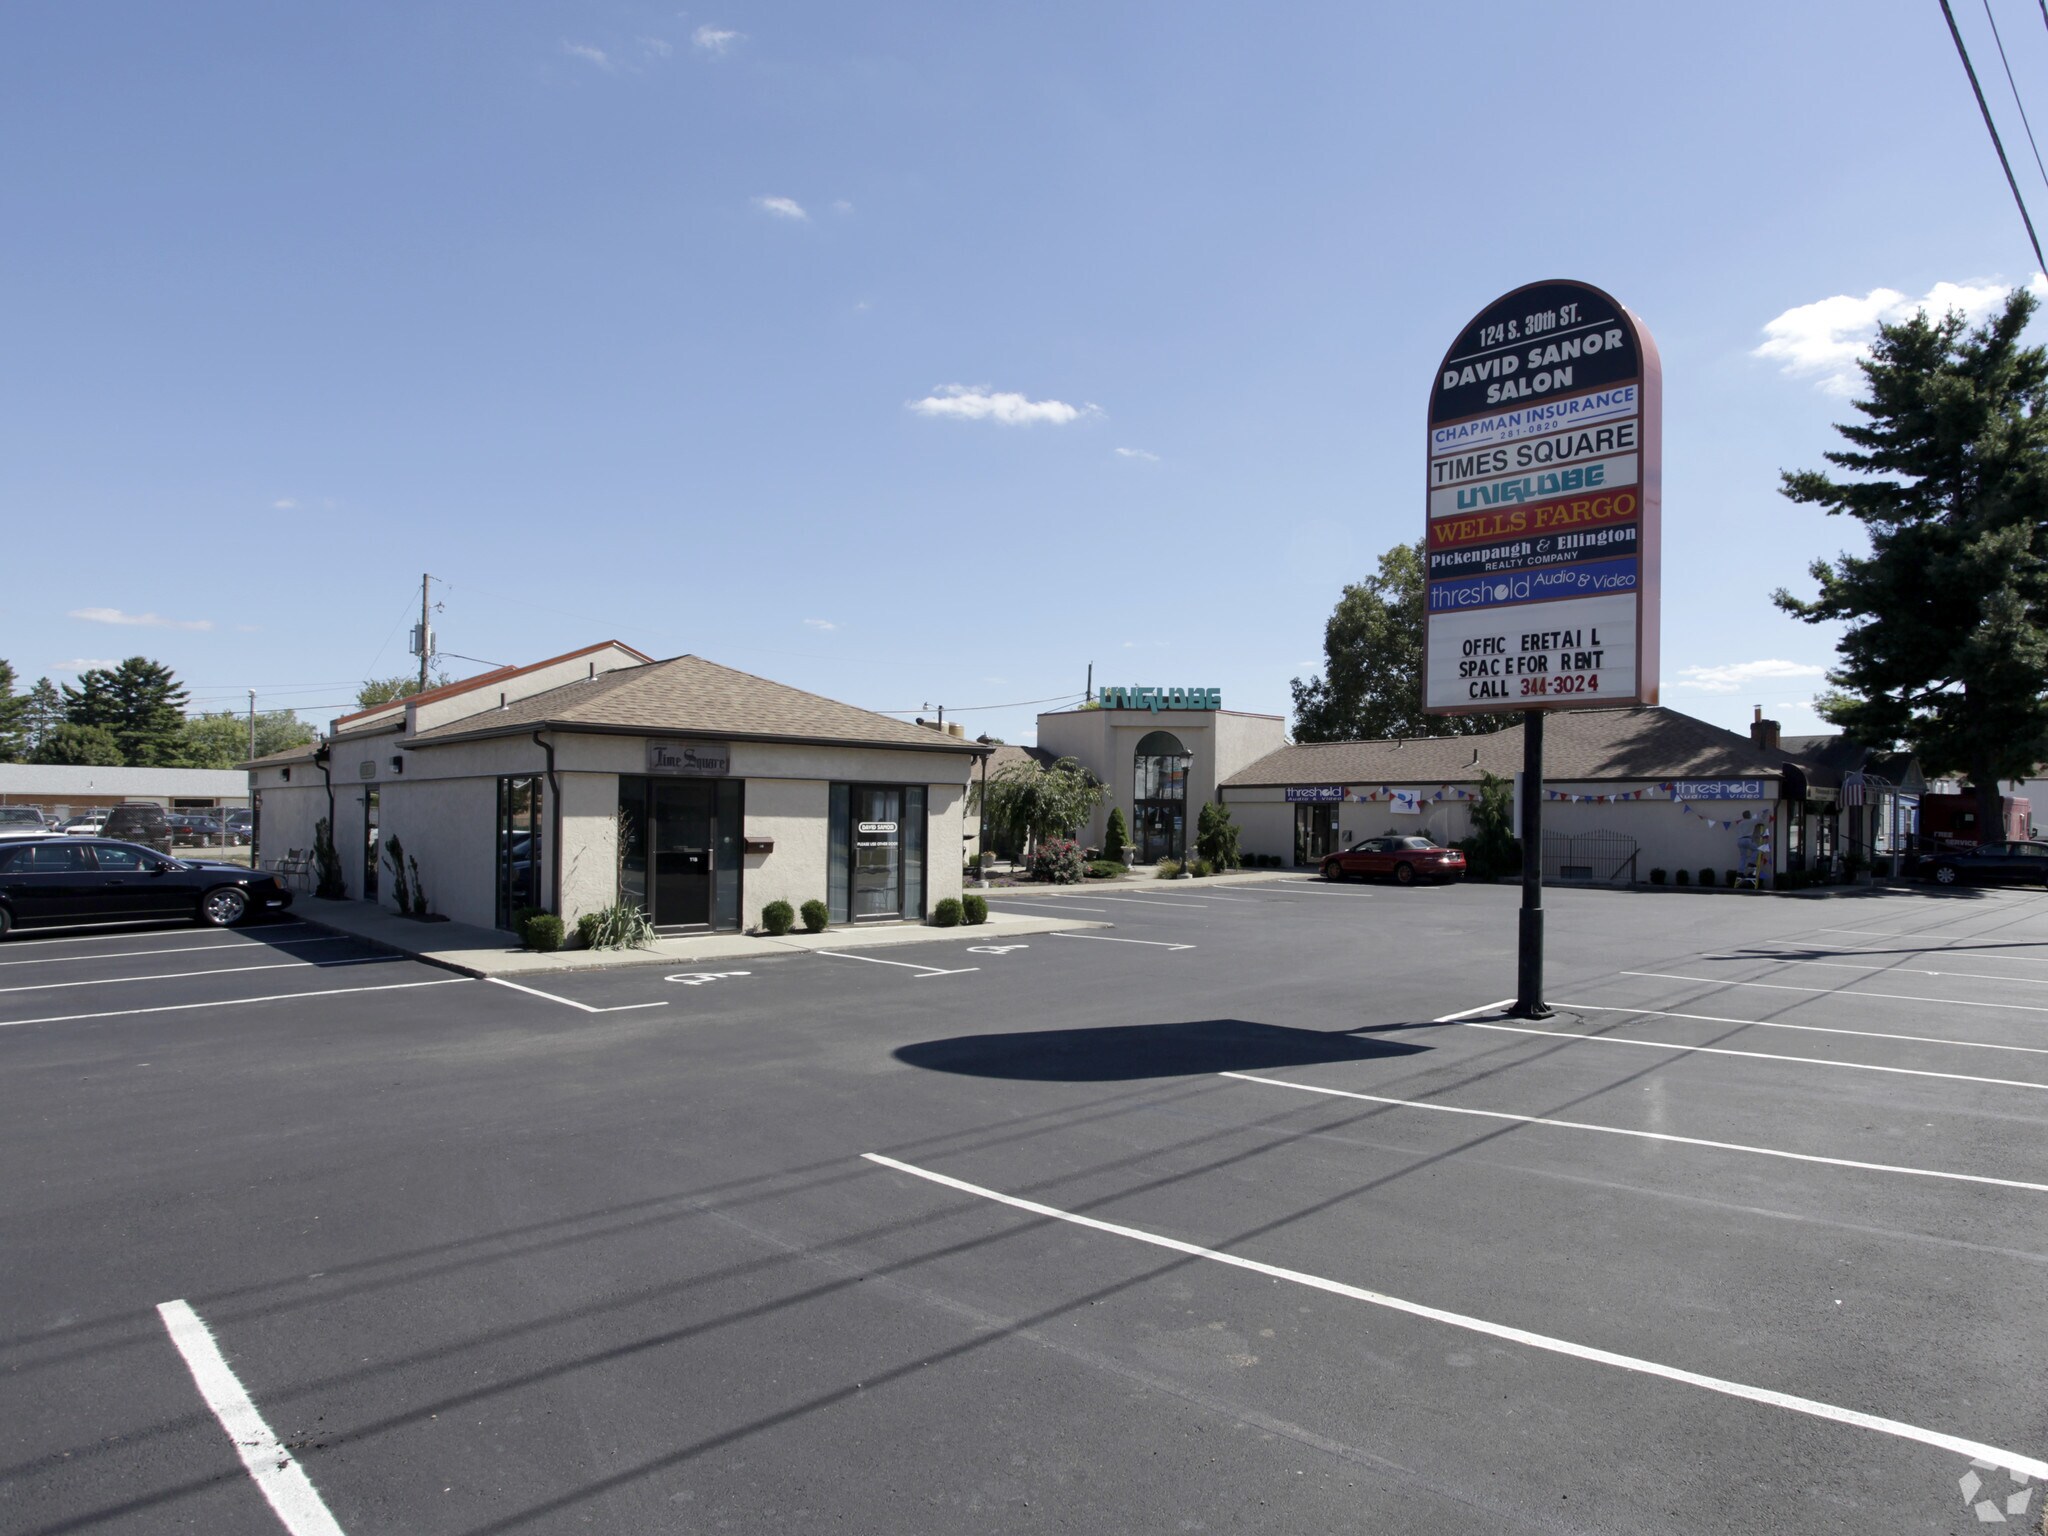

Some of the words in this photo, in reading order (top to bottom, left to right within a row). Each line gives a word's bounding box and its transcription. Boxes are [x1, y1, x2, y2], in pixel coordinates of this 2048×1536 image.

[1479, 323, 1504, 347] 124
[1508, 320, 1521, 340] S.
[1524, 310, 1556, 335] 30th
[1559, 303, 1582, 326] ST.
[1443, 355, 1519, 390] DAVID
[1527, 328, 1623, 369] SANOR
[1486, 366, 1573, 404] SALON
[1435, 413, 1521, 443] CHAPMAN
[1527, 387, 1634, 423] INSURANCE
[1500, 420, 1559, 440] 281-0820
[1434, 449, 1508, 483] TIMES
[1516, 423, 1634, 467] SQUARE
[1457, 464, 1604, 510] UNIGLOBE
[1434, 511, 1527, 543] WELLS
[1534, 494, 1636, 528] FARGO
[1431, 541, 1531, 568] Pickenpaugh
[1536, 539, 1550, 553] &
[1557, 528, 1636, 550] Ellington
[1485, 558, 1523, 571] REALTY
[1527, 551, 1579, 565] COMPANY
[1431, 576, 1530, 608] threshold
[1534, 571, 1575, 587] Audio
[1577, 574, 1590, 587] &
[1592, 574, 1635, 589] Video
[1459, 657, 1514, 678] SPACE
[1518, 654, 1548, 674] FOR
[1561, 650, 1604, 670] RENT
[1100, 687, 1221, 715] UNIGLOBE
[1469, 680, 1509, 698] CALL
[1520, 674, 1598, 696] 344-3024
[683, 749, 725, 770] Square
[1286, 786, 1341, 797] threshold
[1674, 781, 1759, 793] threshold
[1945, 839, 1978, 847] SERVICE
